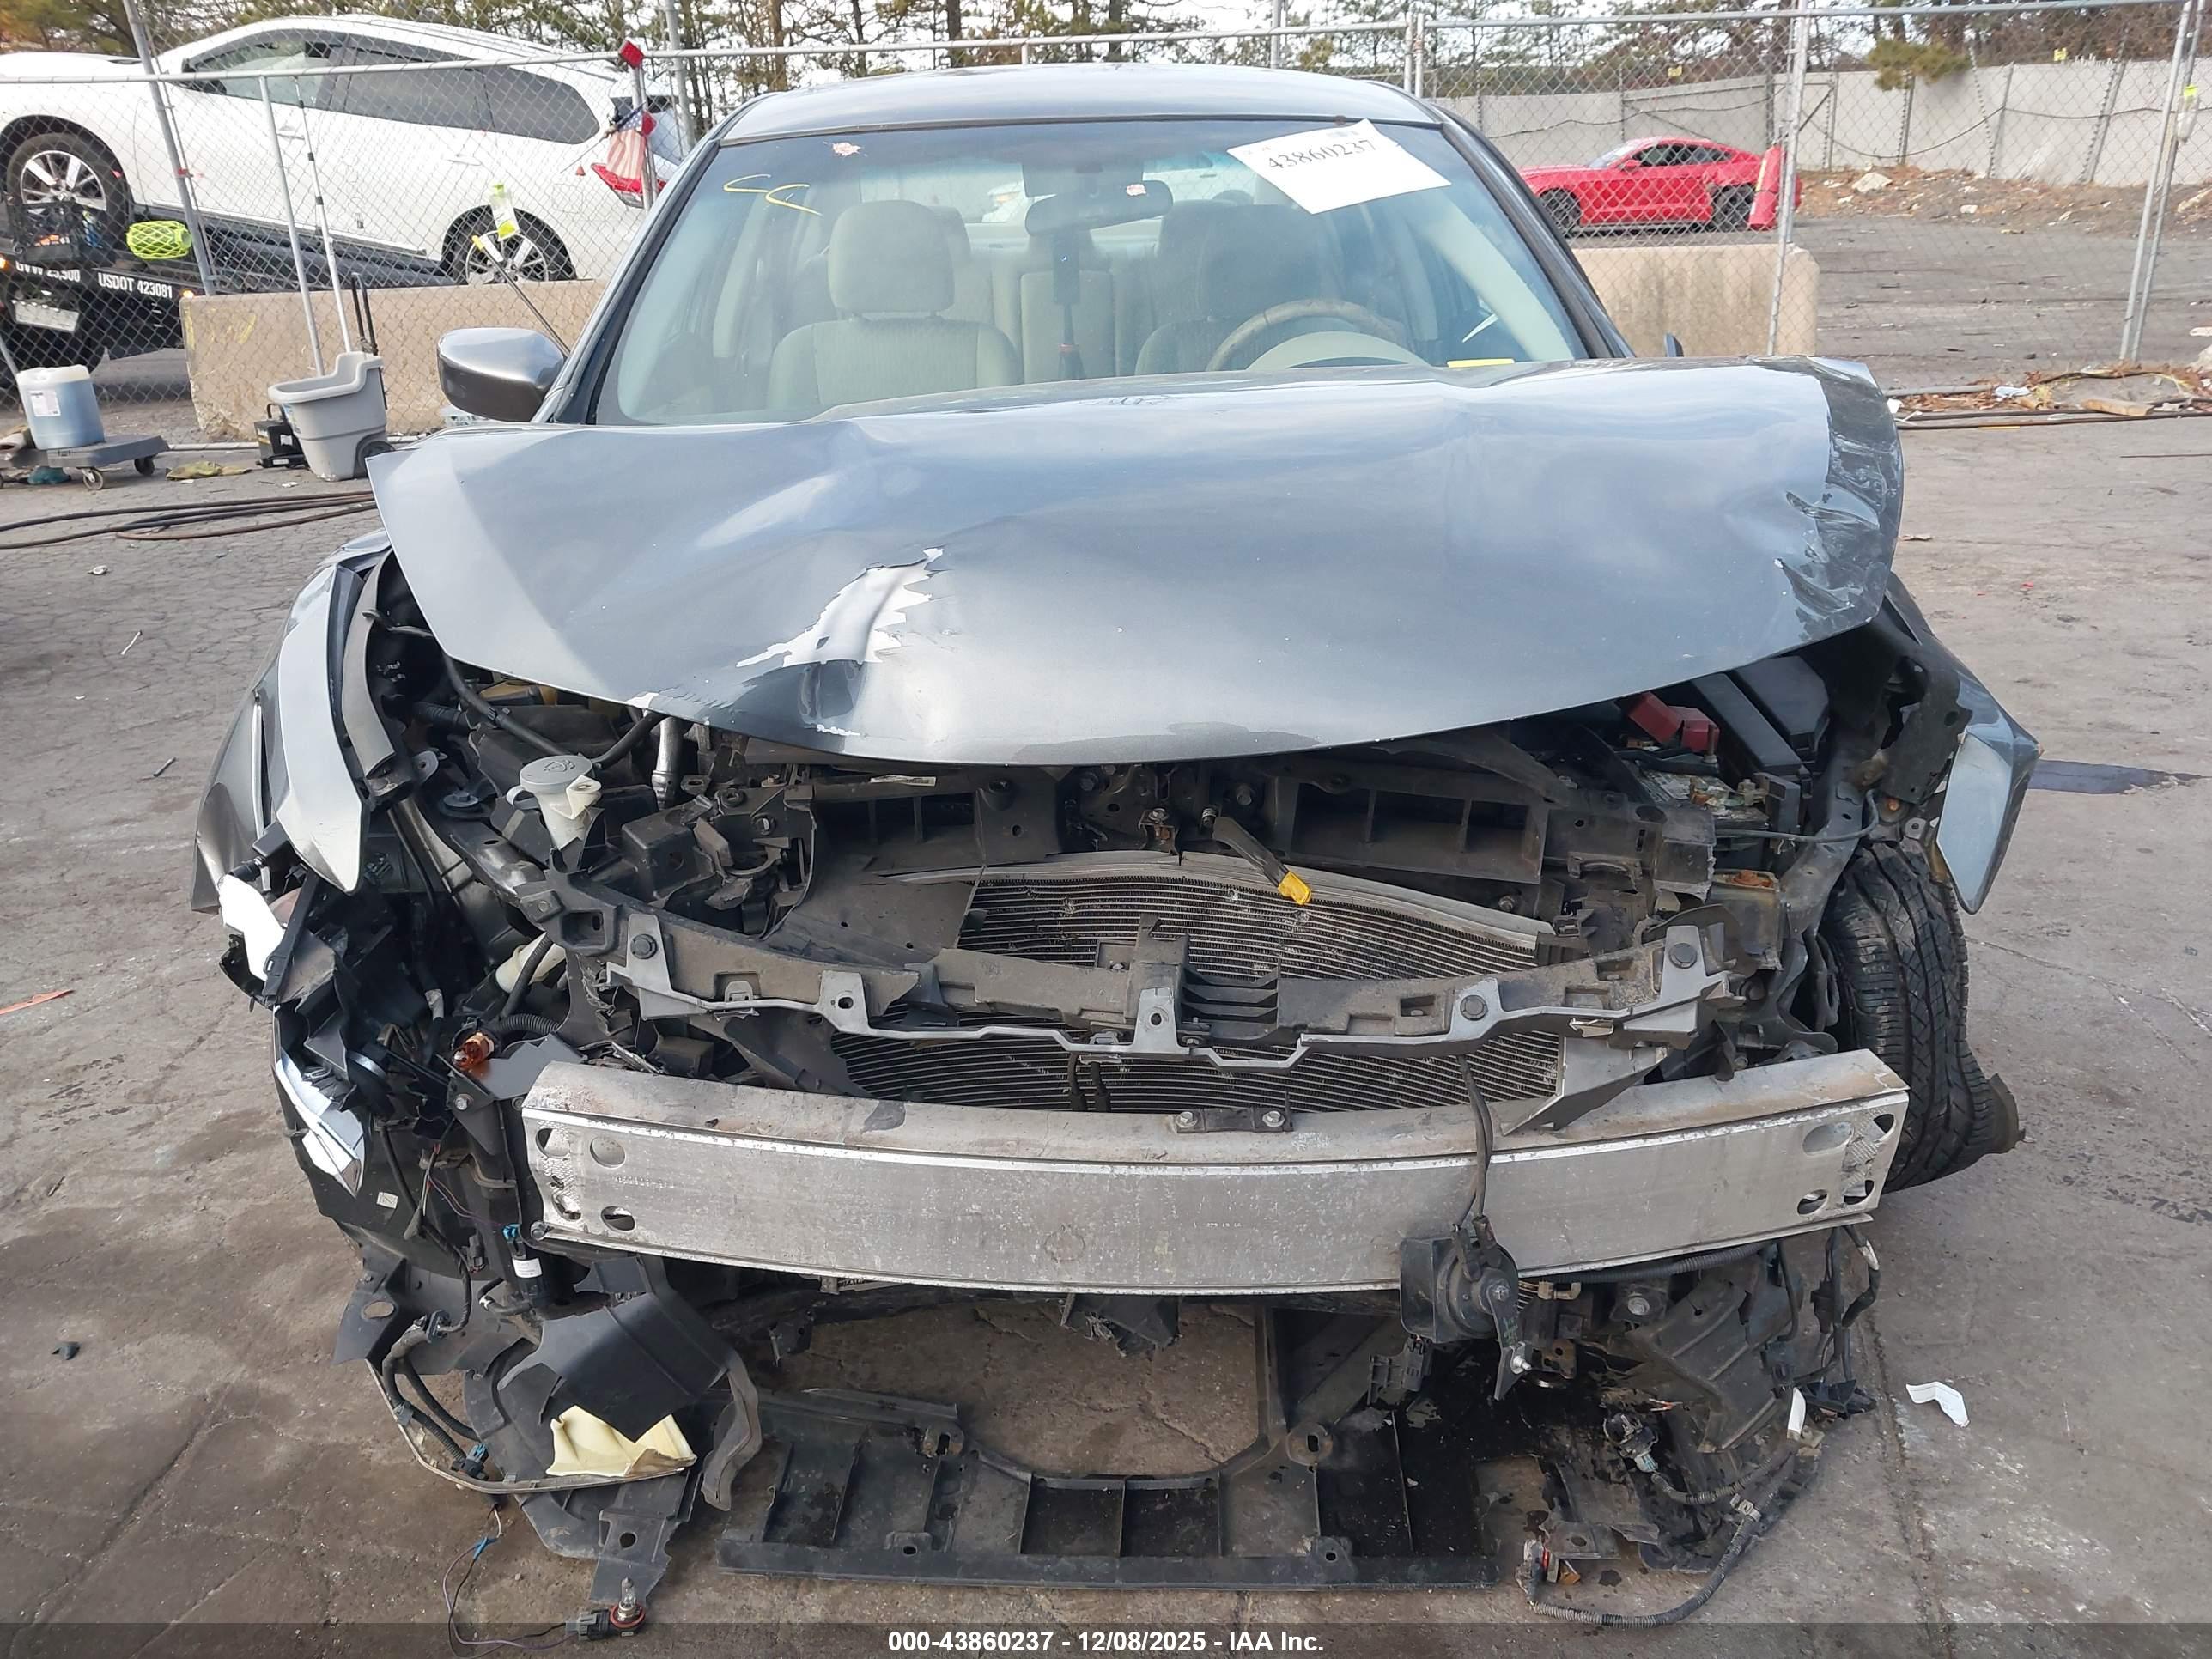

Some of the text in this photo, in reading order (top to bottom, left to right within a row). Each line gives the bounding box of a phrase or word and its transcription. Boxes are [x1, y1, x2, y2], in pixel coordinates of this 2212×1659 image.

[1267, 139, 1376, 169] 43860237
[97, 271, 173, 299] USDOT 423081
